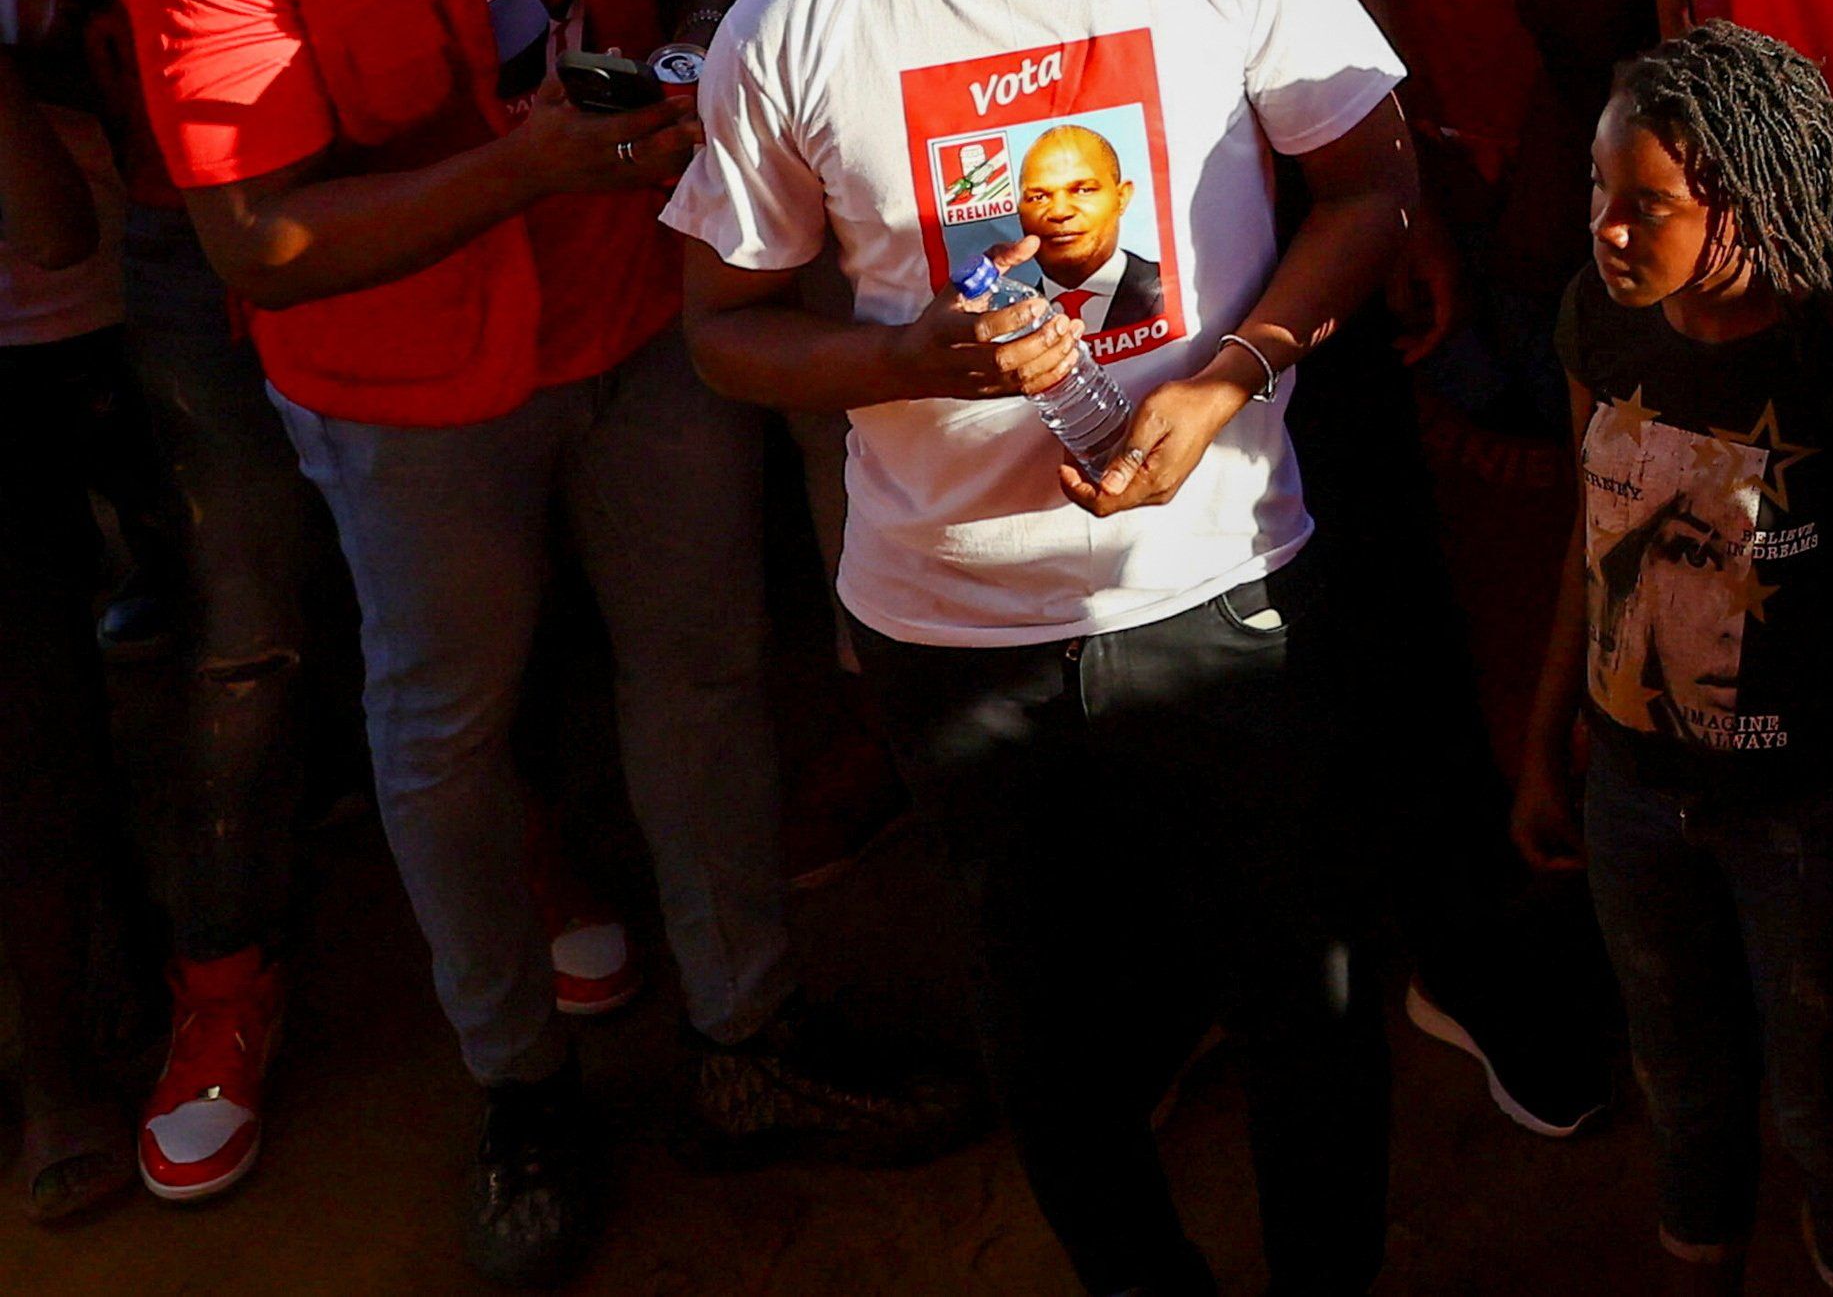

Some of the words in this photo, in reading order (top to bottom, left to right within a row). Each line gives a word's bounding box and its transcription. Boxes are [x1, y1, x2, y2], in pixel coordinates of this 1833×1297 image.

[970, 51, 1062, 116] Vota
[947, 202, 1015, 223] FRELIMO
[1741, 523, 1815, 546] BELIEVE
[1751, 534, 1819, 560] DREAMS
